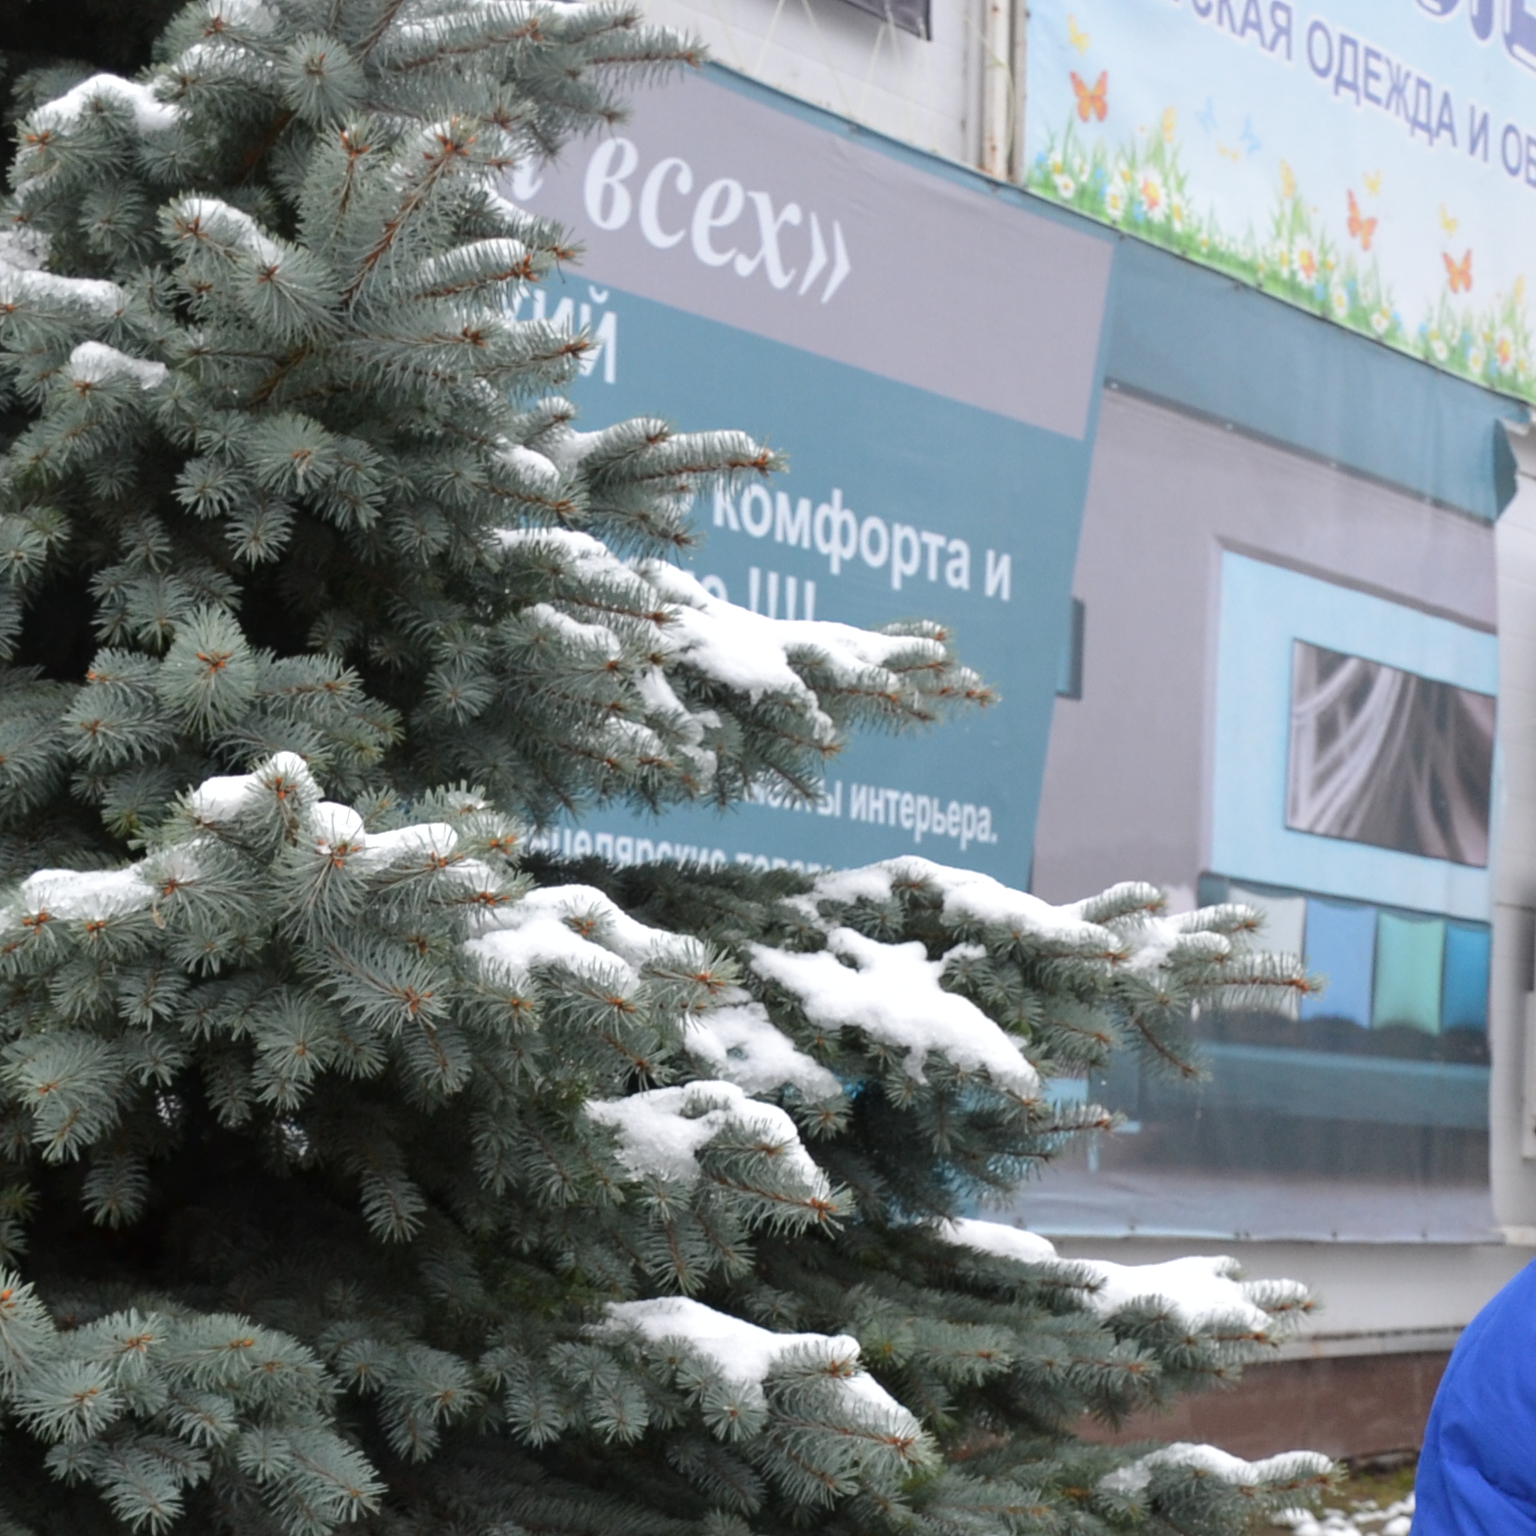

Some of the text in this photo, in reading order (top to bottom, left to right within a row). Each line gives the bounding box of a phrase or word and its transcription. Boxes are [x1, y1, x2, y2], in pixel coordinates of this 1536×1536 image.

[1306, 20, 1458, 148] ОДЕЖДА
[1469, 104, 1490, 164] И
[583, 137, 853, 304] всех»
[712, 476, 971, 591] комфорта
[985, 547, 1013, 602] и
[849, 782, 998, 852] интерьера.
